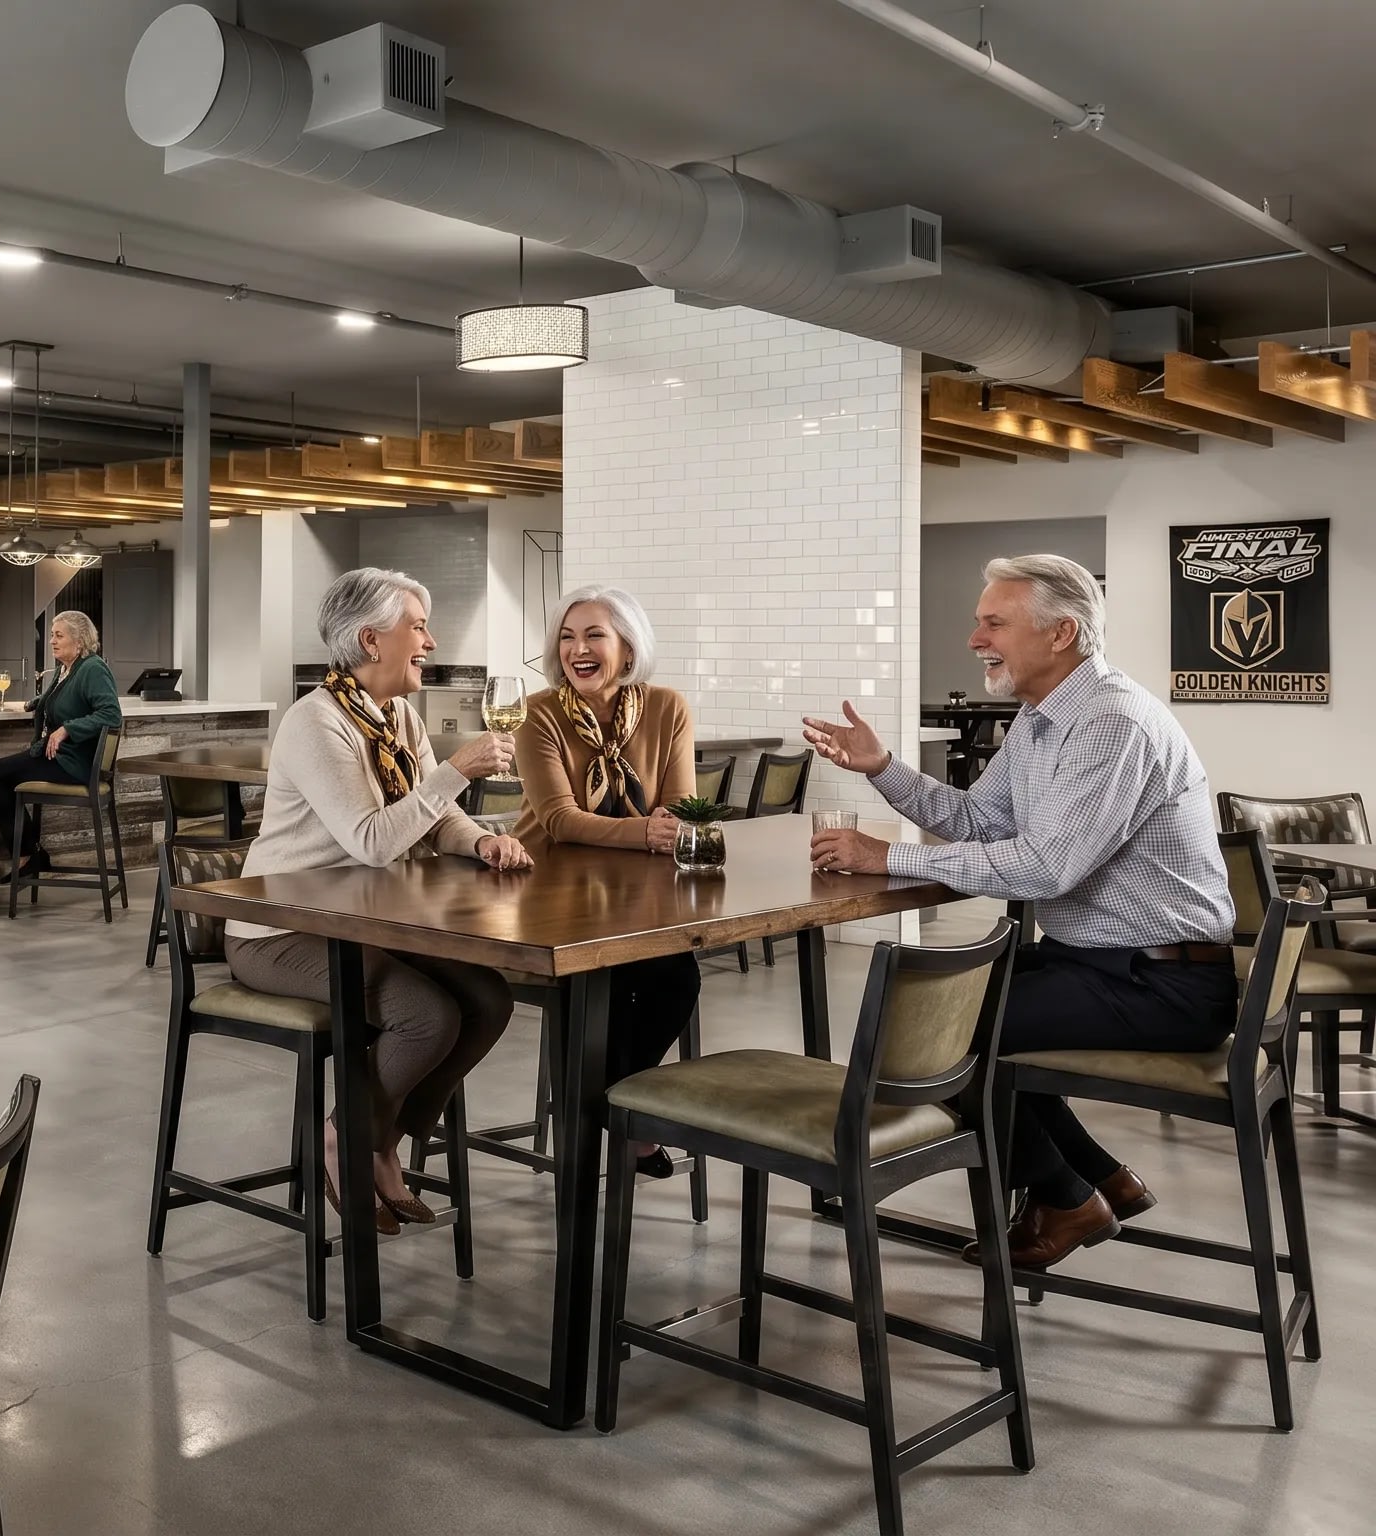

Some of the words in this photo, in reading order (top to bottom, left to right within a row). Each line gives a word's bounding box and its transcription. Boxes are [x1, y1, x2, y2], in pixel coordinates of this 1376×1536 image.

[1183, 538, 1317, 558] FINAL
[1175, 673, 1242, 691] GOLDEN
[1248, 674, 1326, 692] KNIGHTS
